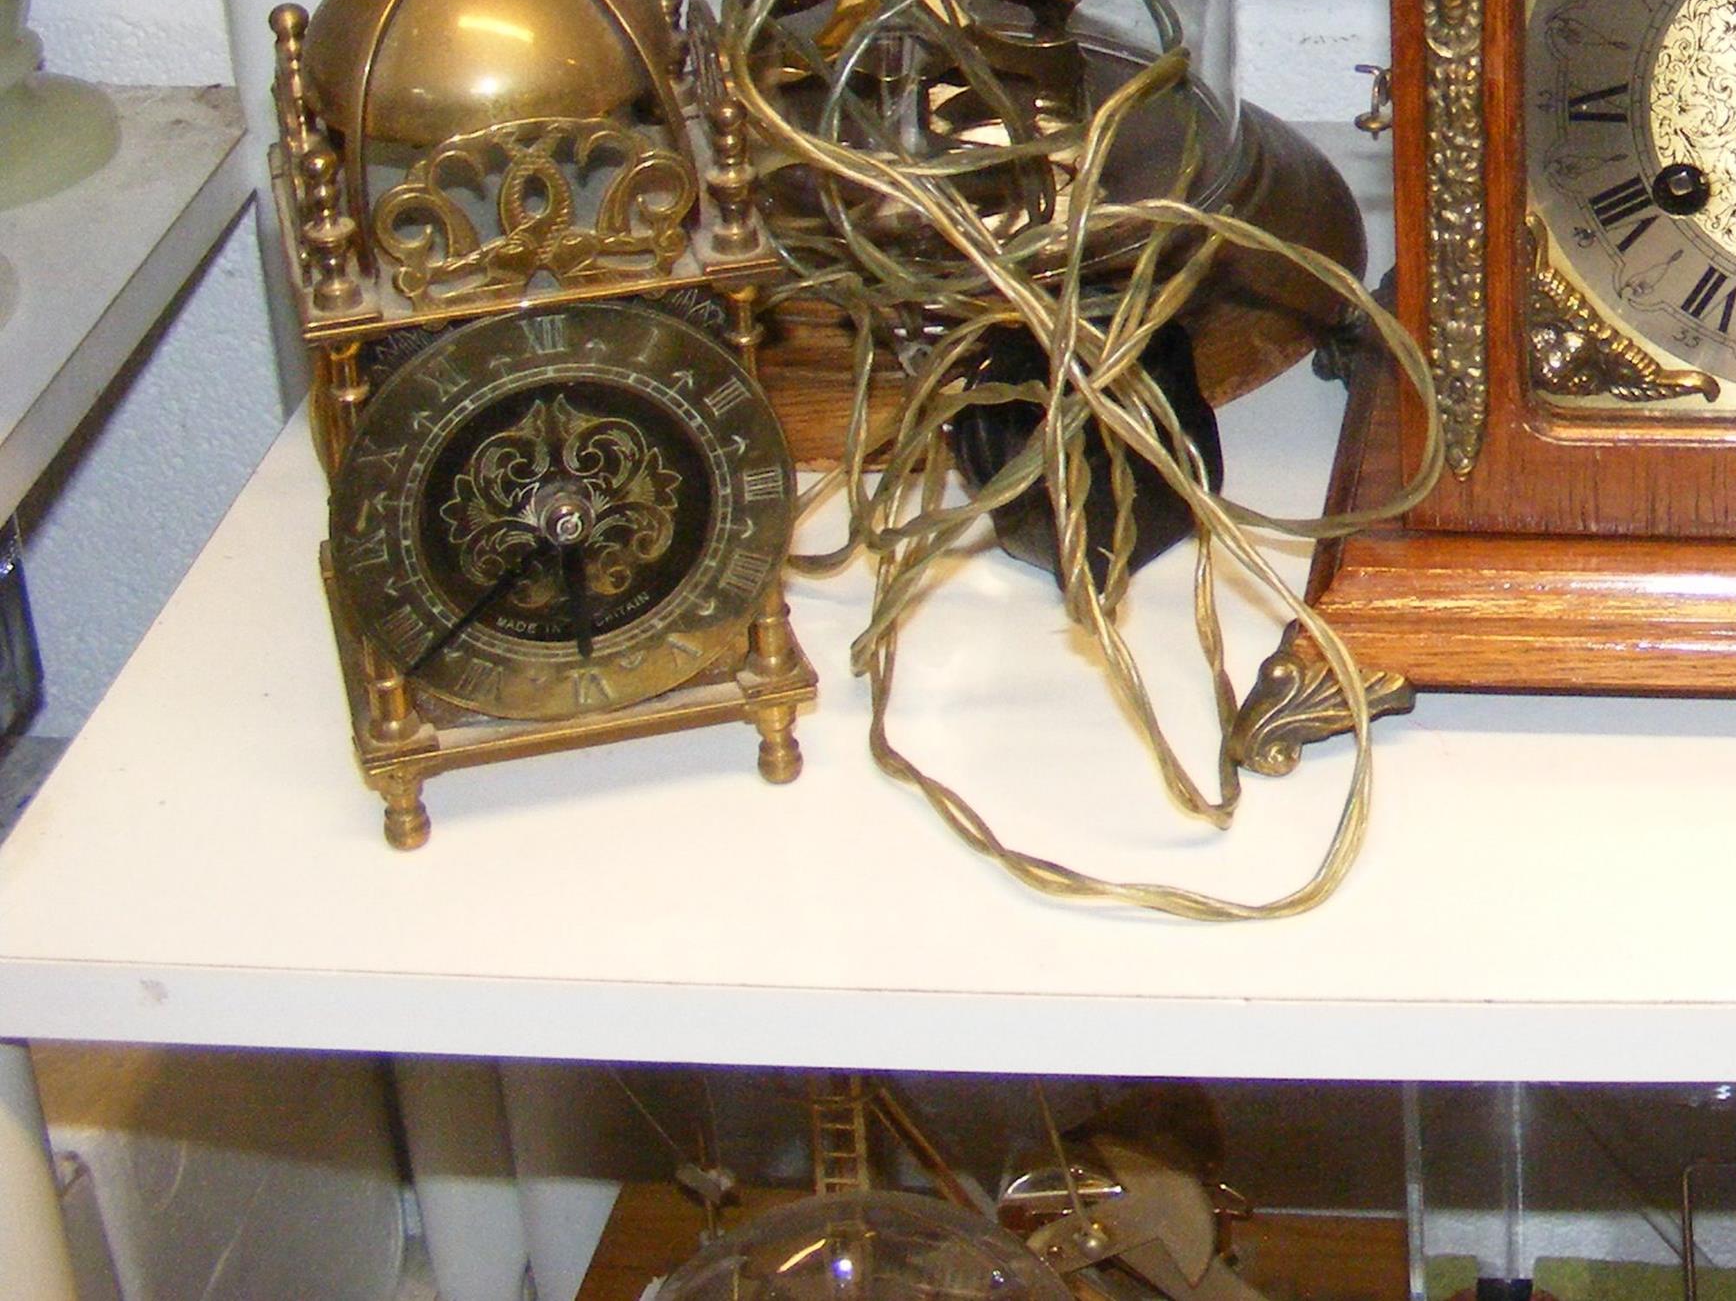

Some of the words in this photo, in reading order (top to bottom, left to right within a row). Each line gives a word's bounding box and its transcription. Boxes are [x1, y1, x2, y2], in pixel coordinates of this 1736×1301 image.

[1672, 328, 1702, 348] 35
[496, 616, 538, 634] MADE
[546, 625, 562, 634] IN
